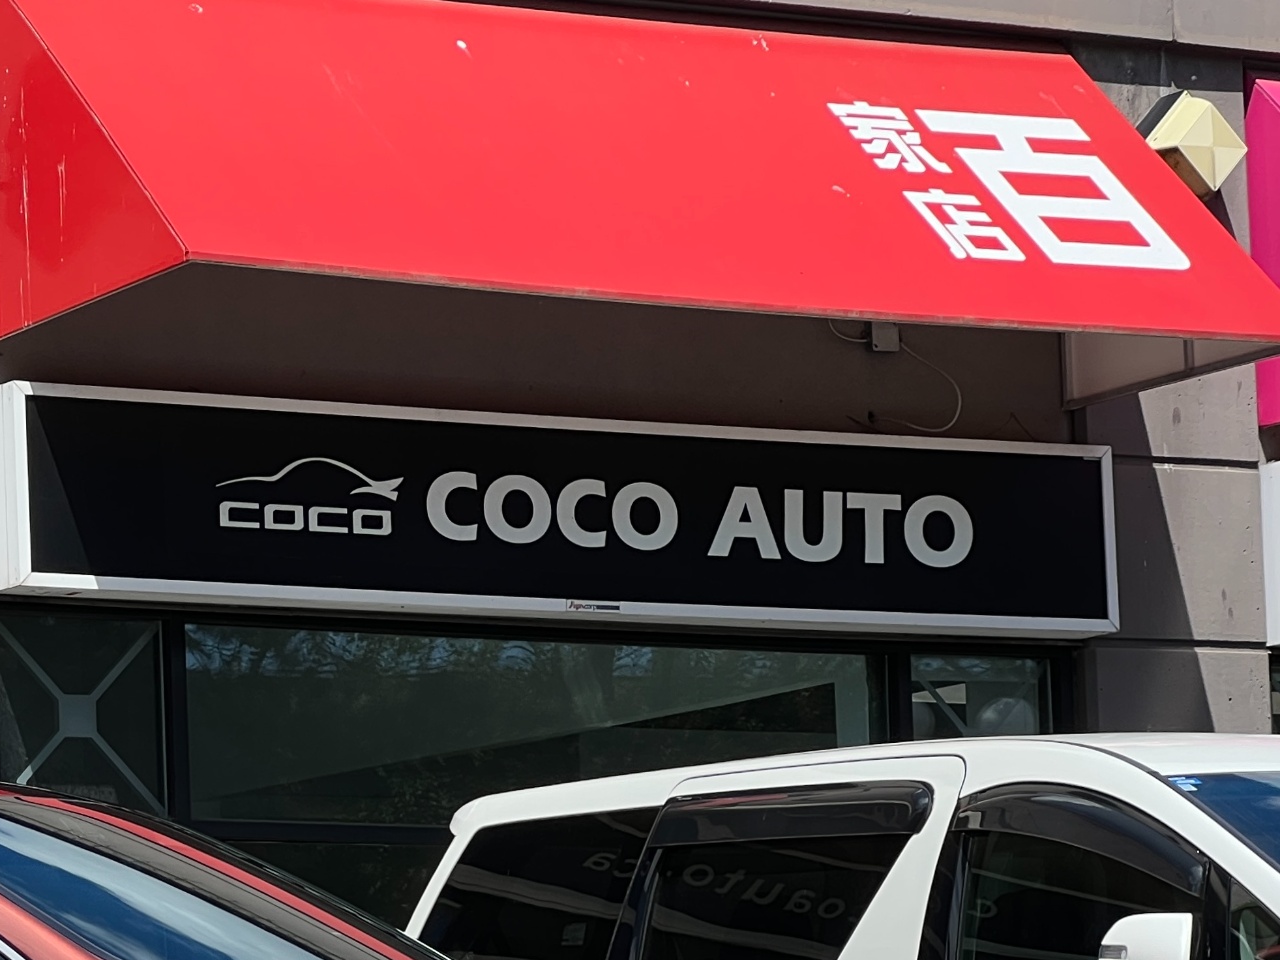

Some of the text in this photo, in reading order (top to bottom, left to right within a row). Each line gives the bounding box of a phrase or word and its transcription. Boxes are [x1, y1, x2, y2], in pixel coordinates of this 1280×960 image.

[219, 500, 392, 536] COCO
[426, 471, 974, 568] COCO AUTO
